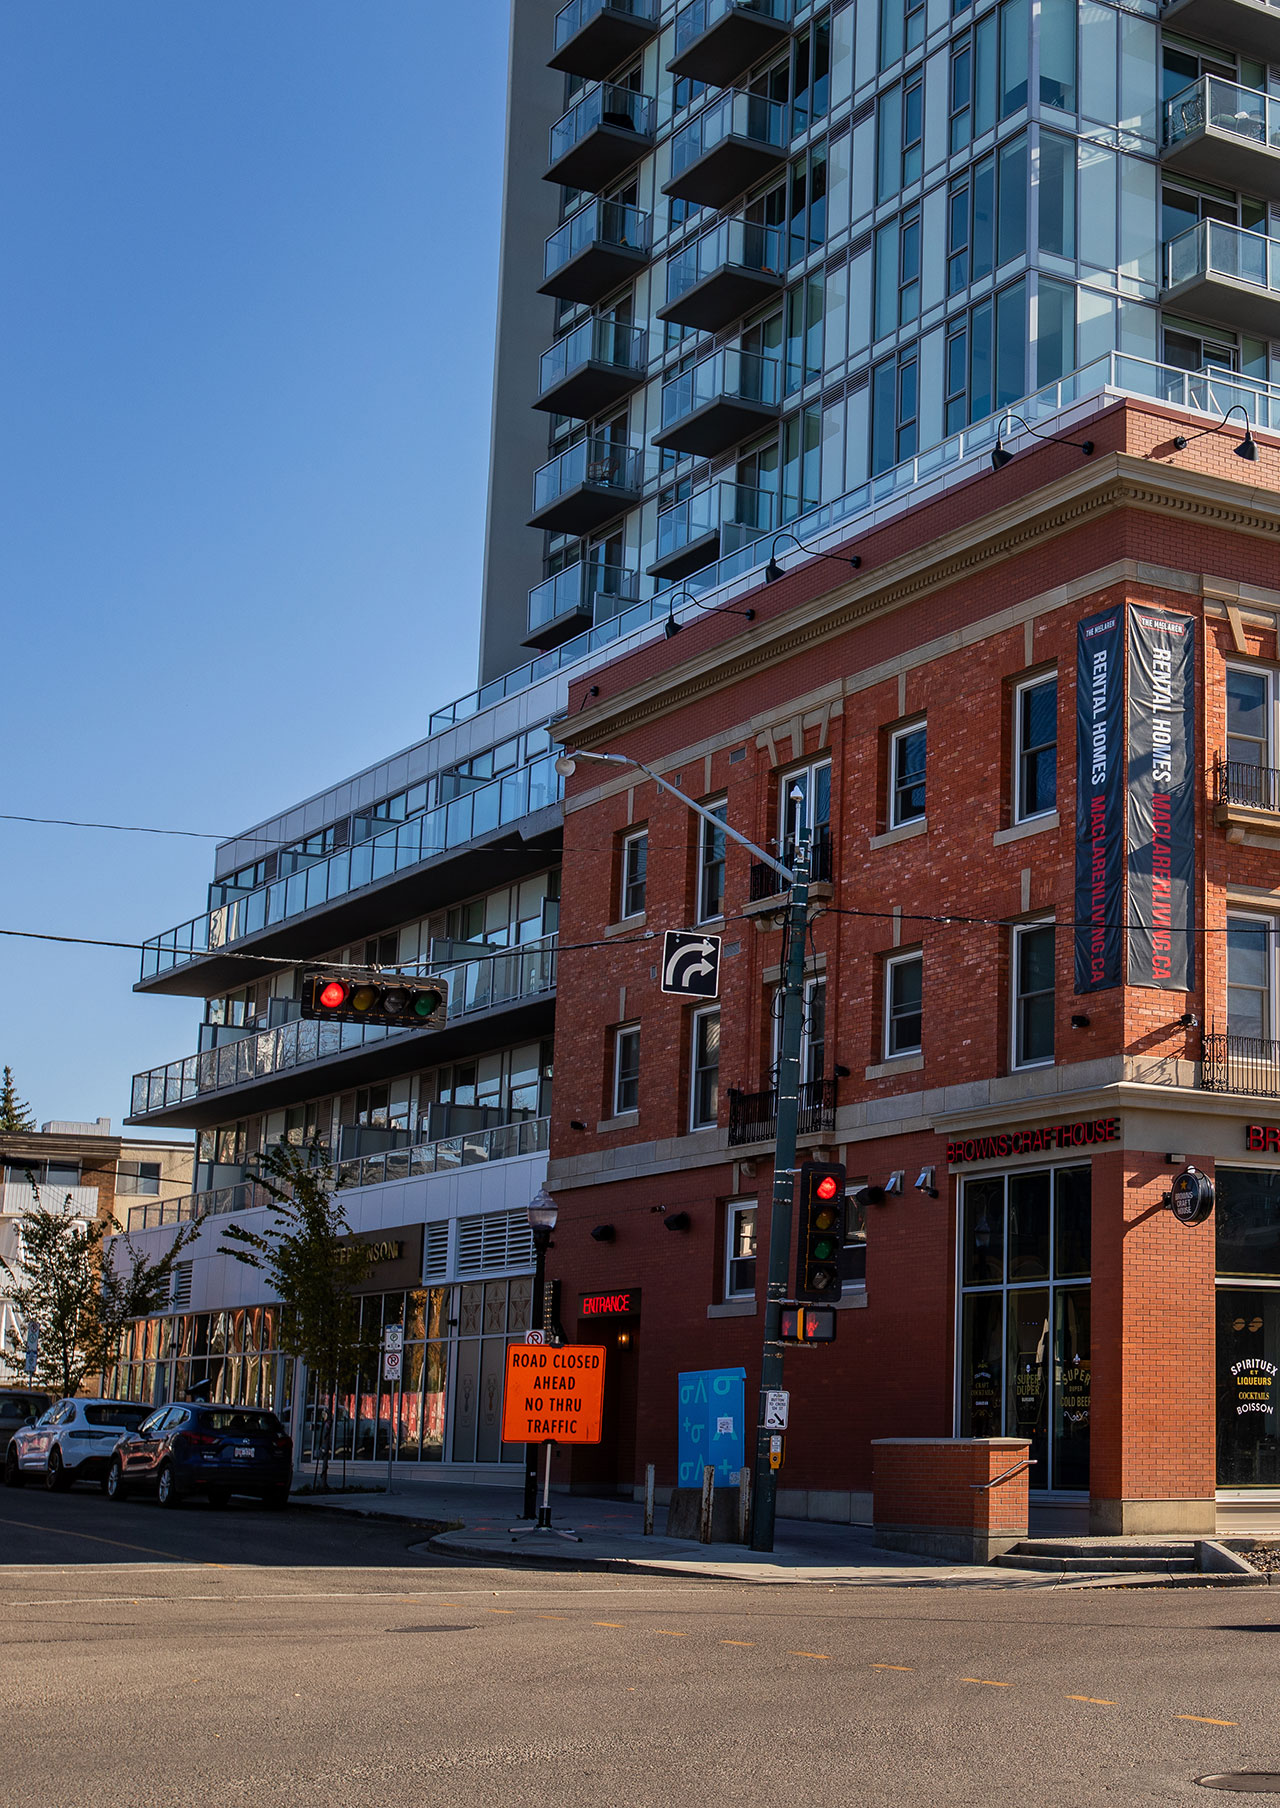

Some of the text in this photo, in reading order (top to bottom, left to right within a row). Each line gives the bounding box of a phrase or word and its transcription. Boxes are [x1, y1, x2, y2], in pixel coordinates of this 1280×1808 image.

[1091, 650, 1107, 785] RENTAL HOMES
[1152, 647, 1172, 783] RENTAL HOMES
[1151, 793, 1172, 980] MACLARENLIVING.CA
[947, 1134, 1008, 1163] BROWNS
[1175, 1191, 1193, 1200] BROWNS
[1177, 1199, 1191, 1208] CRAFT
[1178, 1207, 1191, 1215] HOUSE
[583, 1294, 630, 1315] ENTRANCE
[513, 1354, 600, 1369] ROAD CLOSED
[1230, 1358, 1279, 1377] SPIRITUEX
[533, 1376, 576, 1390] AHEAD
[1016, 1374, 1040, 1385] SUPER
[1062, 1368, 1091, 1386] SUPER
[1236, 1376, 1272, 1386] LIQUEURS
[1016, 1385, 1040, 1396] DUPER
[1238, 1391, 1270, 1400] COCKTAILS
[525, 1397, 582, 1412] NO THRU
[1236, 1402, 1274, 1415] BOISSON
[527, 1419, 578, 1433] TRAFFIC
